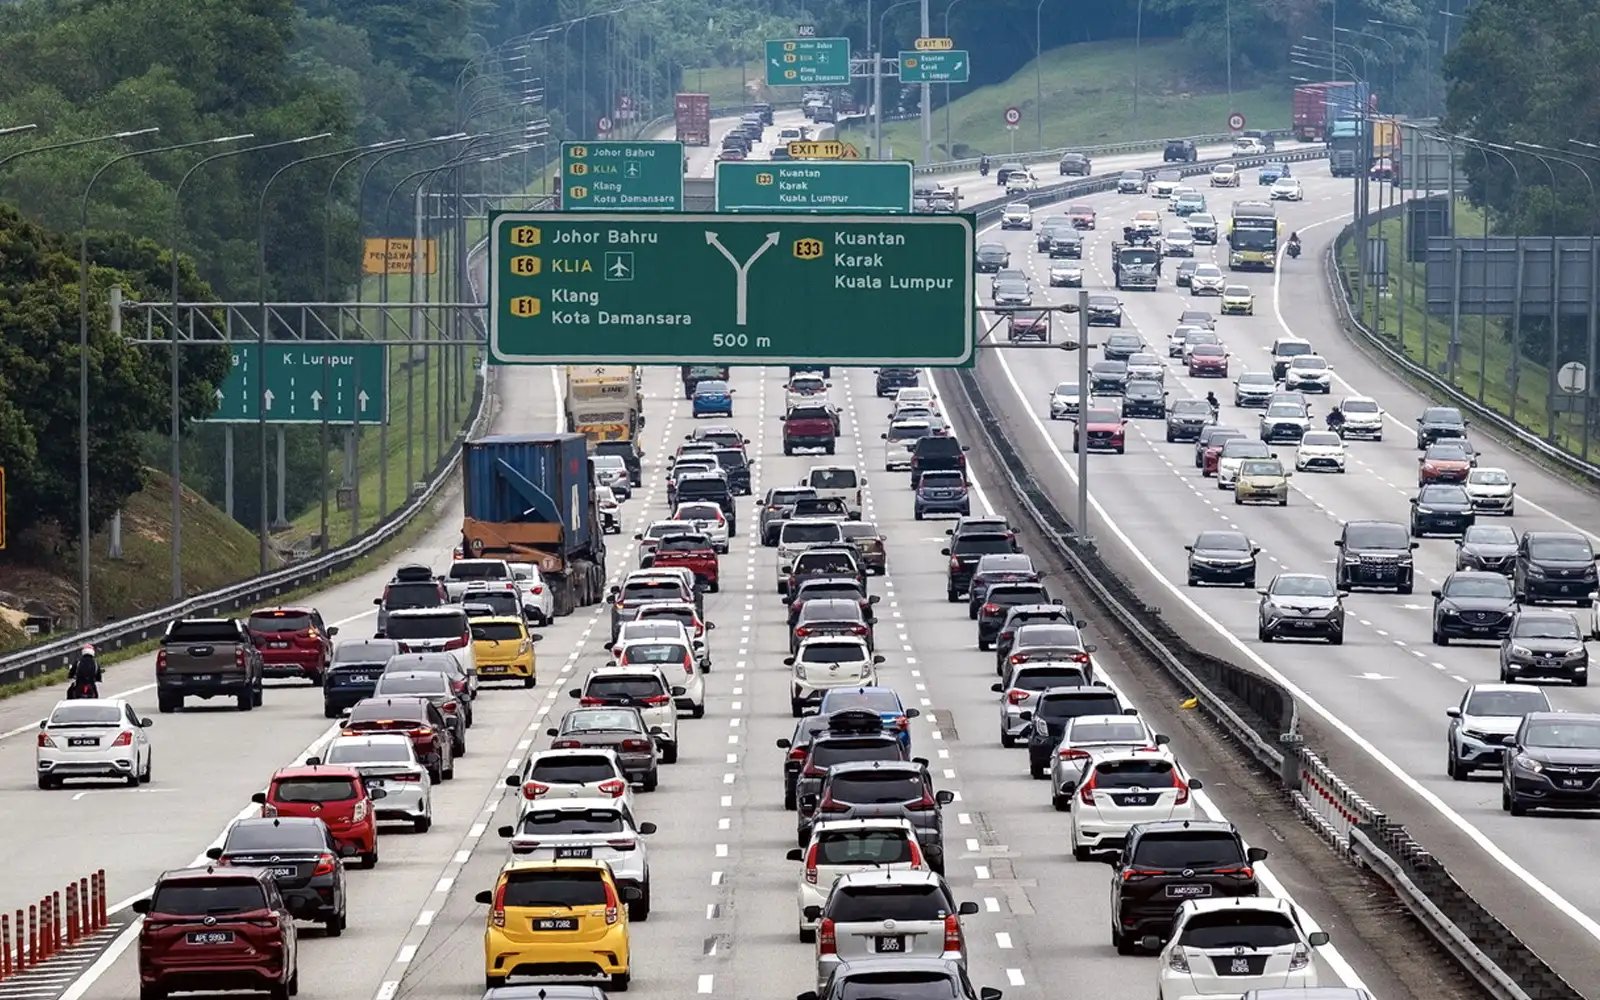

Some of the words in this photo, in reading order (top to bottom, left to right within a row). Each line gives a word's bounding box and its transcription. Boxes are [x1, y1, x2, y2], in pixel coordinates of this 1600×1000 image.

[593, 148, 621, 157] Johor
[625, 148, 656, 157] Bahru
[791, 144, 818, 154] EXIT
[824, 145, 839, 154] 111
[593, 166, 618, 174] KLIA
[780, 169, 820, 178] Kuantan
[593, 182, 622, 192] Klang
[780, 182, 808, 190] Karak
[593, 195, 616, 203] Kota
[620, 195, 674, 203] Damansara
[780, 194, 807, 202] Kuala
[811, 194, 848, 204] Lumpur
[517, 229, 534, 244] E2
[552, 230, 600, 244] Johor
[608, 230, 658, 244] Bahru
[834, 232, 905, 246] Kuantan
[796, 241, 821, 256] E33
[517, 258, 534, 274] E6
[552, 259, 594, 274] KLIA
[834, 253, 883, 268] Karak
[834, 275, 882, 290] Kuala
[890, 275, 954, 290] Lumpur
[552, 288, 599, 306] Klang
[518, 300, 533, 314] E1
[552, 311, 590, 326] Kota
[598, 311, 692, 326] Damansara
[712, 334, 748, 348] 500
[756, 337, 770, 348] m
[283, 352, 296, 364] K.
[195, 934, 208, 942] APE
